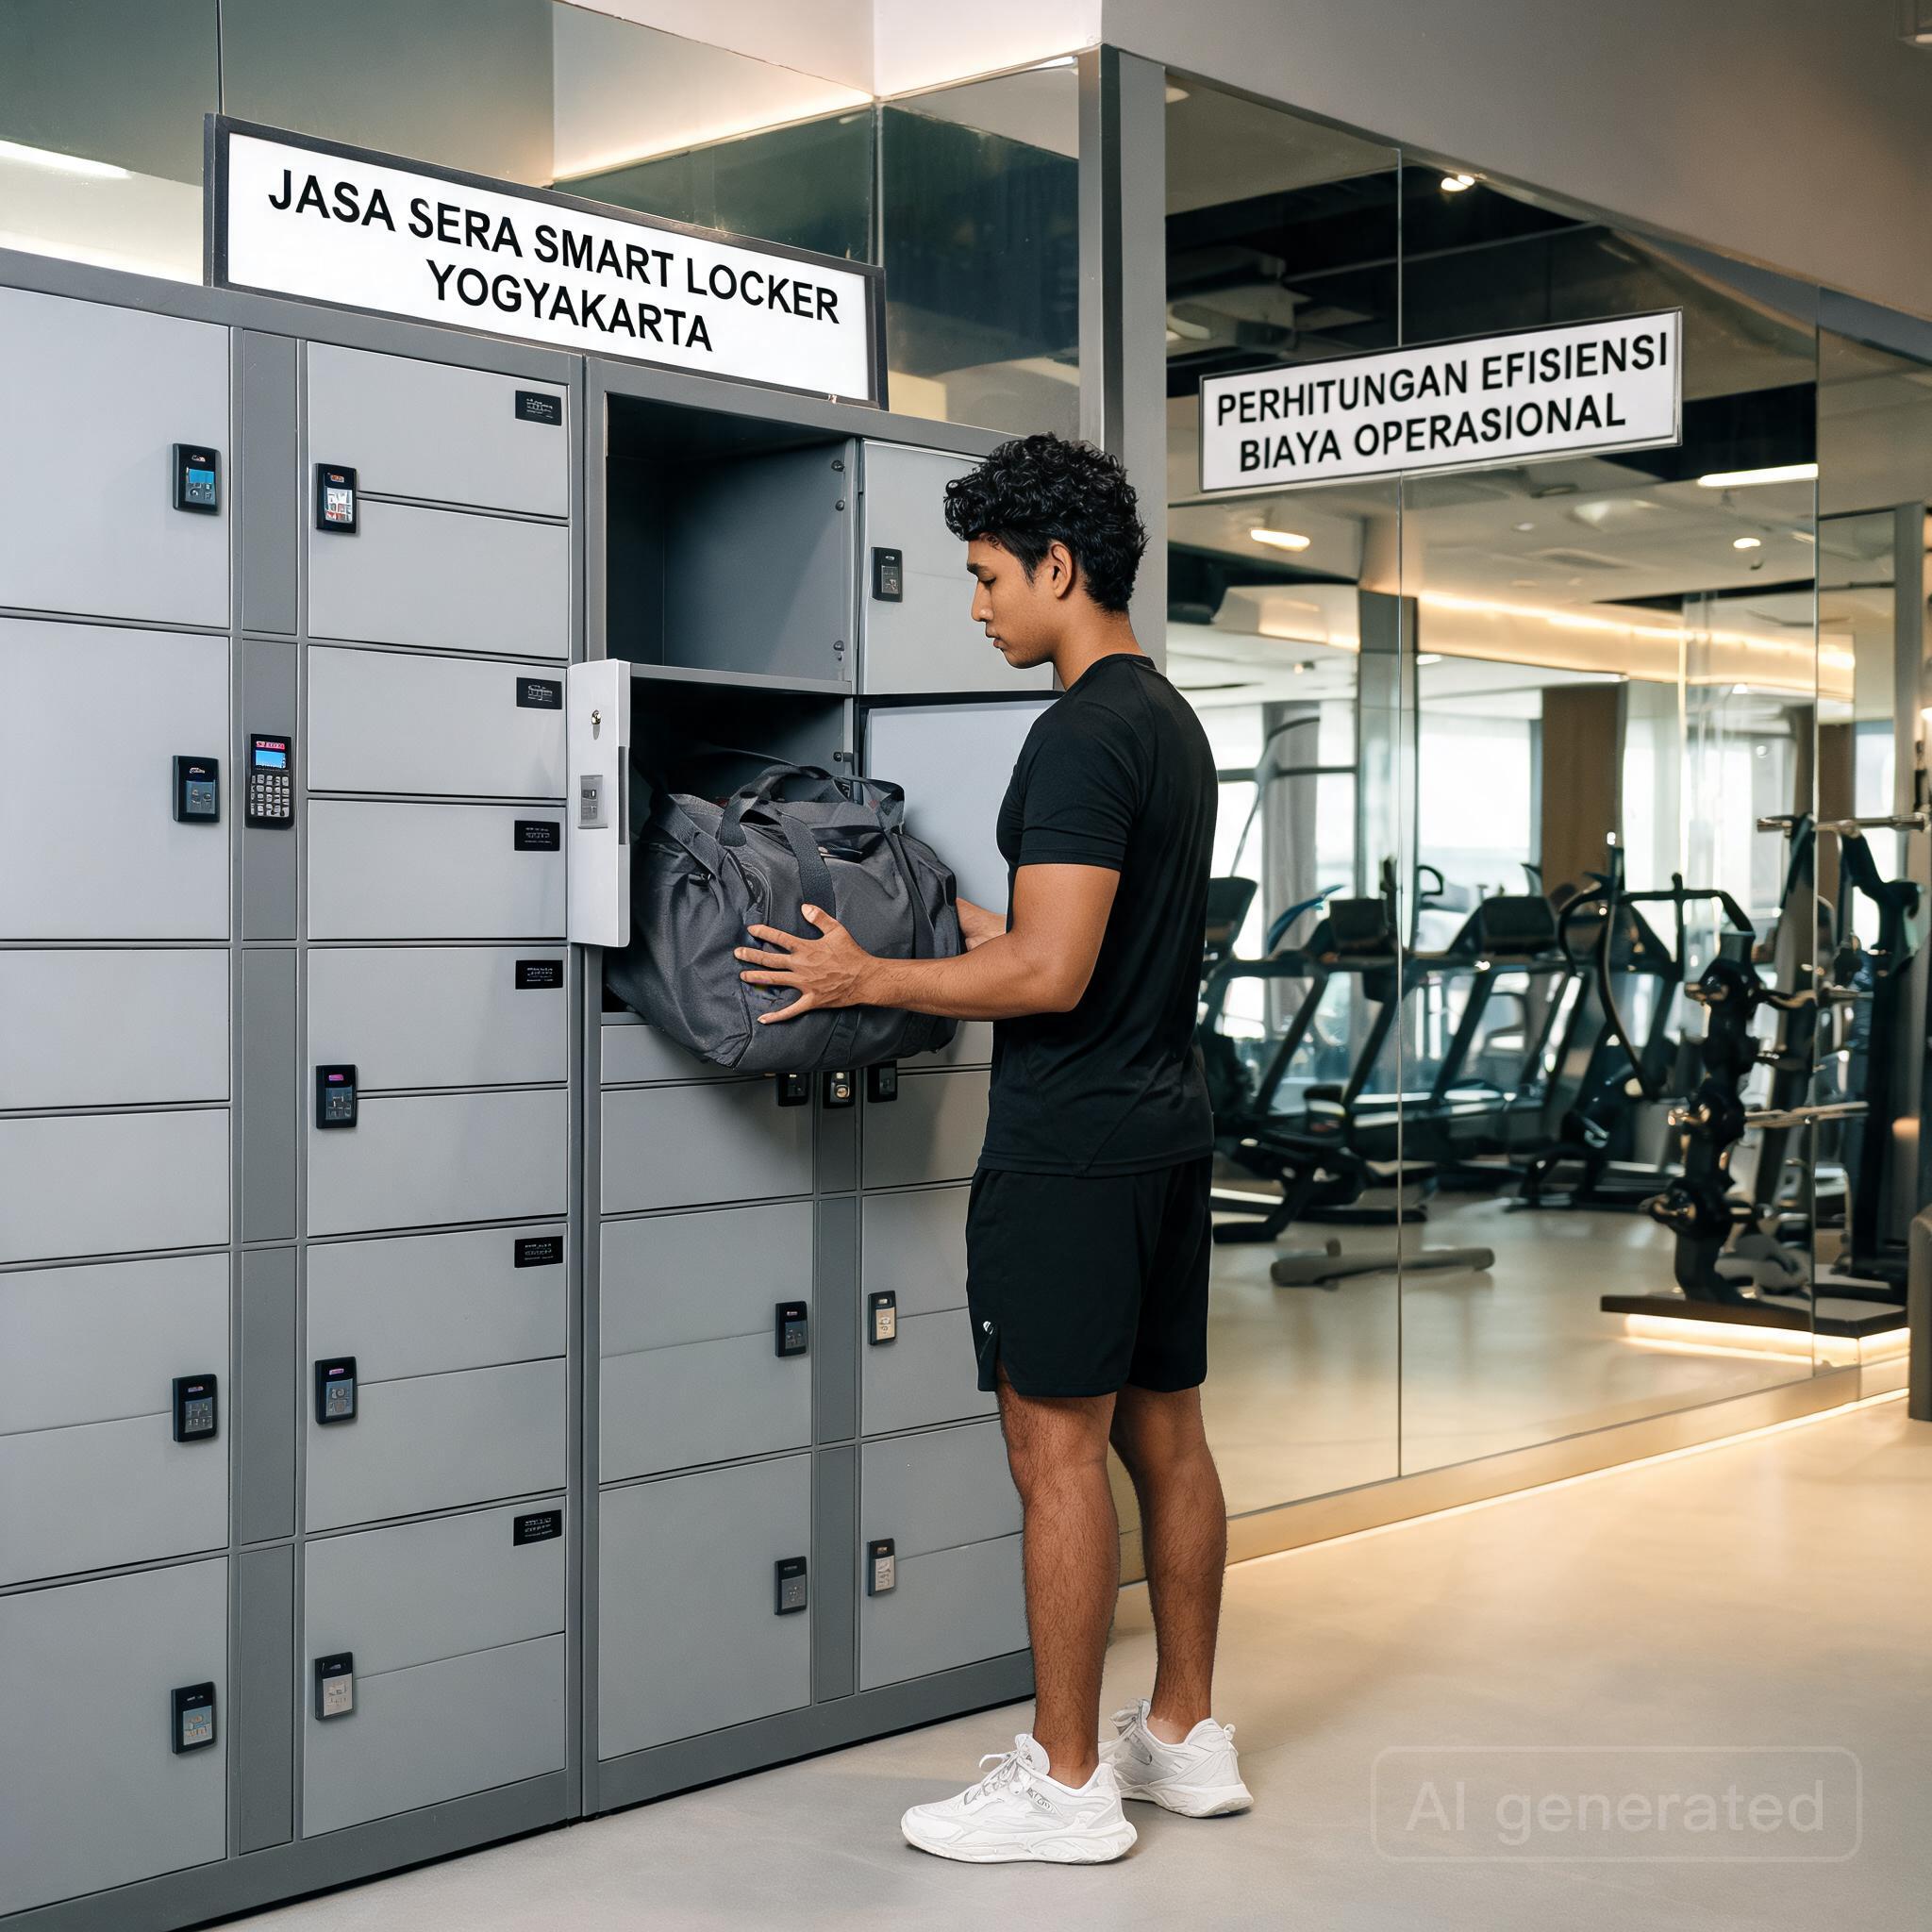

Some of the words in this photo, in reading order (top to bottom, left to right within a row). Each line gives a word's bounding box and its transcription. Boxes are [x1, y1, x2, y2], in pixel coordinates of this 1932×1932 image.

[268, 169, 396, 232] JASA
[408, 197, 524, 258] SERA
[534, 225, 675, 288] SMART
[687, 257, 840, 325] LOCKER
[425, 258, 713, 352] YOGYAKARTA
[1218, 359, 1467, 426] PERHITUNGAN
[1482, 331, 1667, 391] EFISIENSI
[1240, 429, 1341, 473] BIAYA
[1354, 392, 1626, 457] OPERASIONAL
